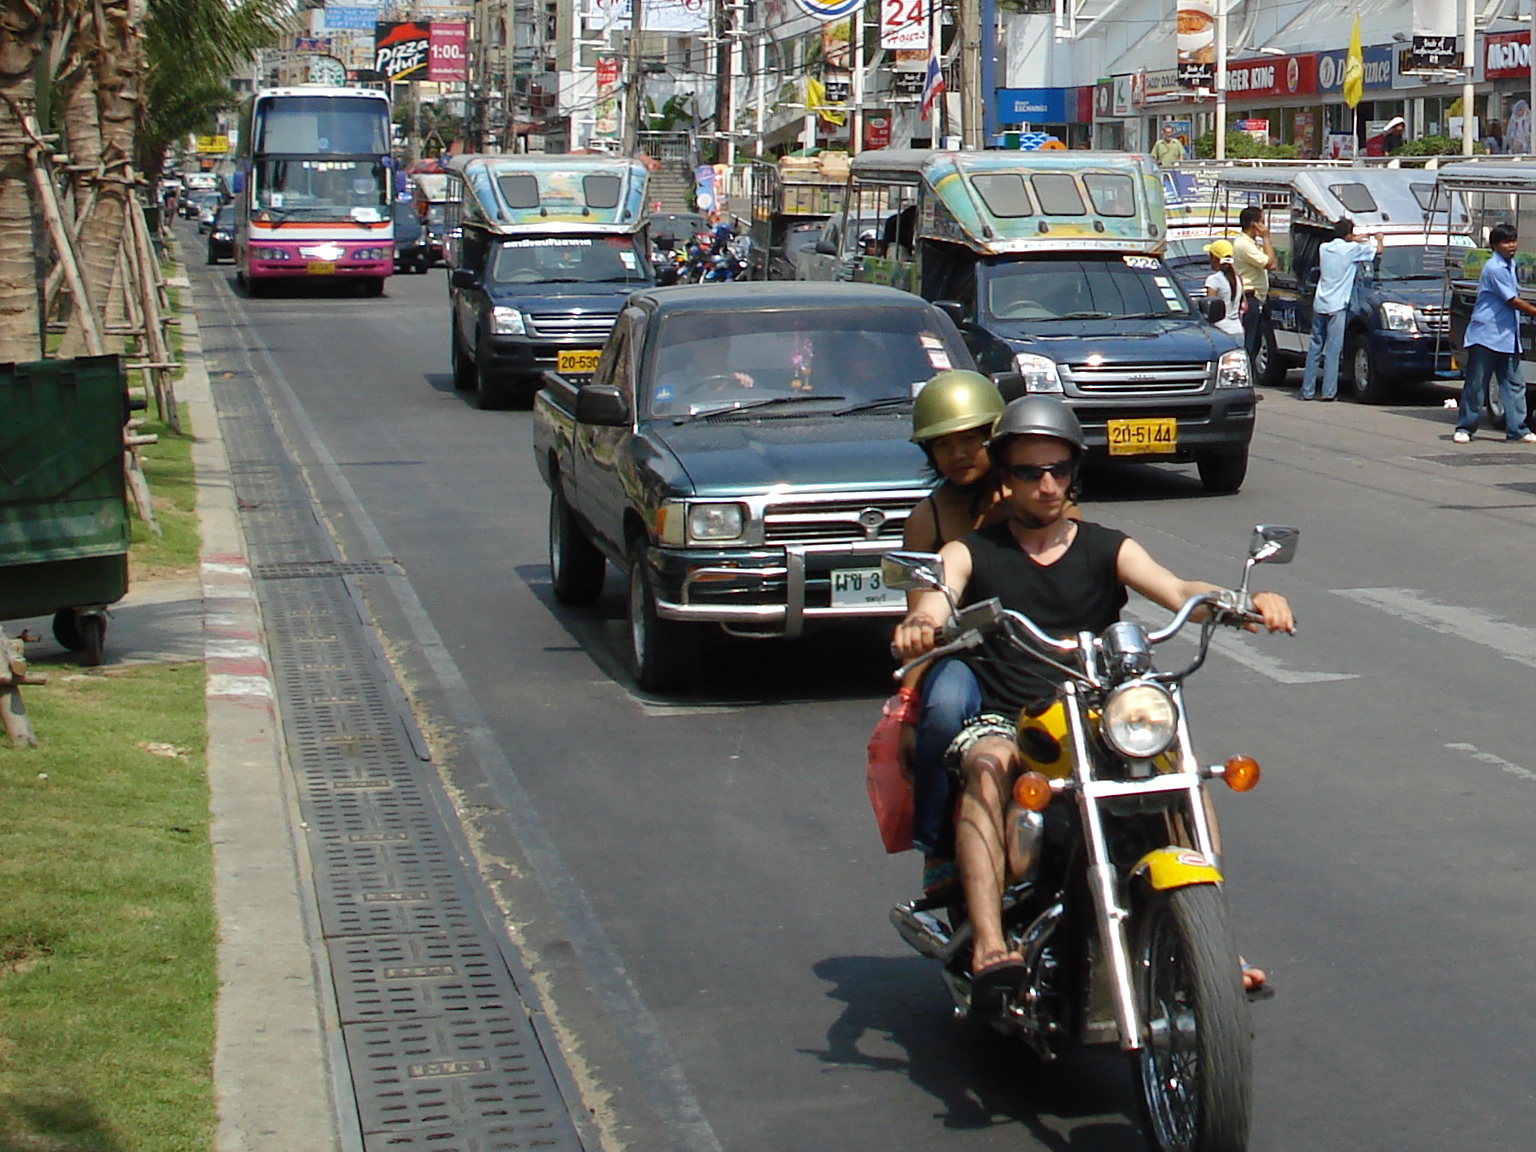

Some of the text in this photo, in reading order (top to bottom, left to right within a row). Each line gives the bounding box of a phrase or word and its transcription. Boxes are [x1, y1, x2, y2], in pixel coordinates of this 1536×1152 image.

[886, 29, 926, 45] Hours
[376, 39, 430, 73] Pizza
[431, 44, 459, 59] 1:00
[385, 53, 425, 78] Hut
[1251, 64, 1275, 90] KING
[1112, 424, 1172, 444] 20-5144
